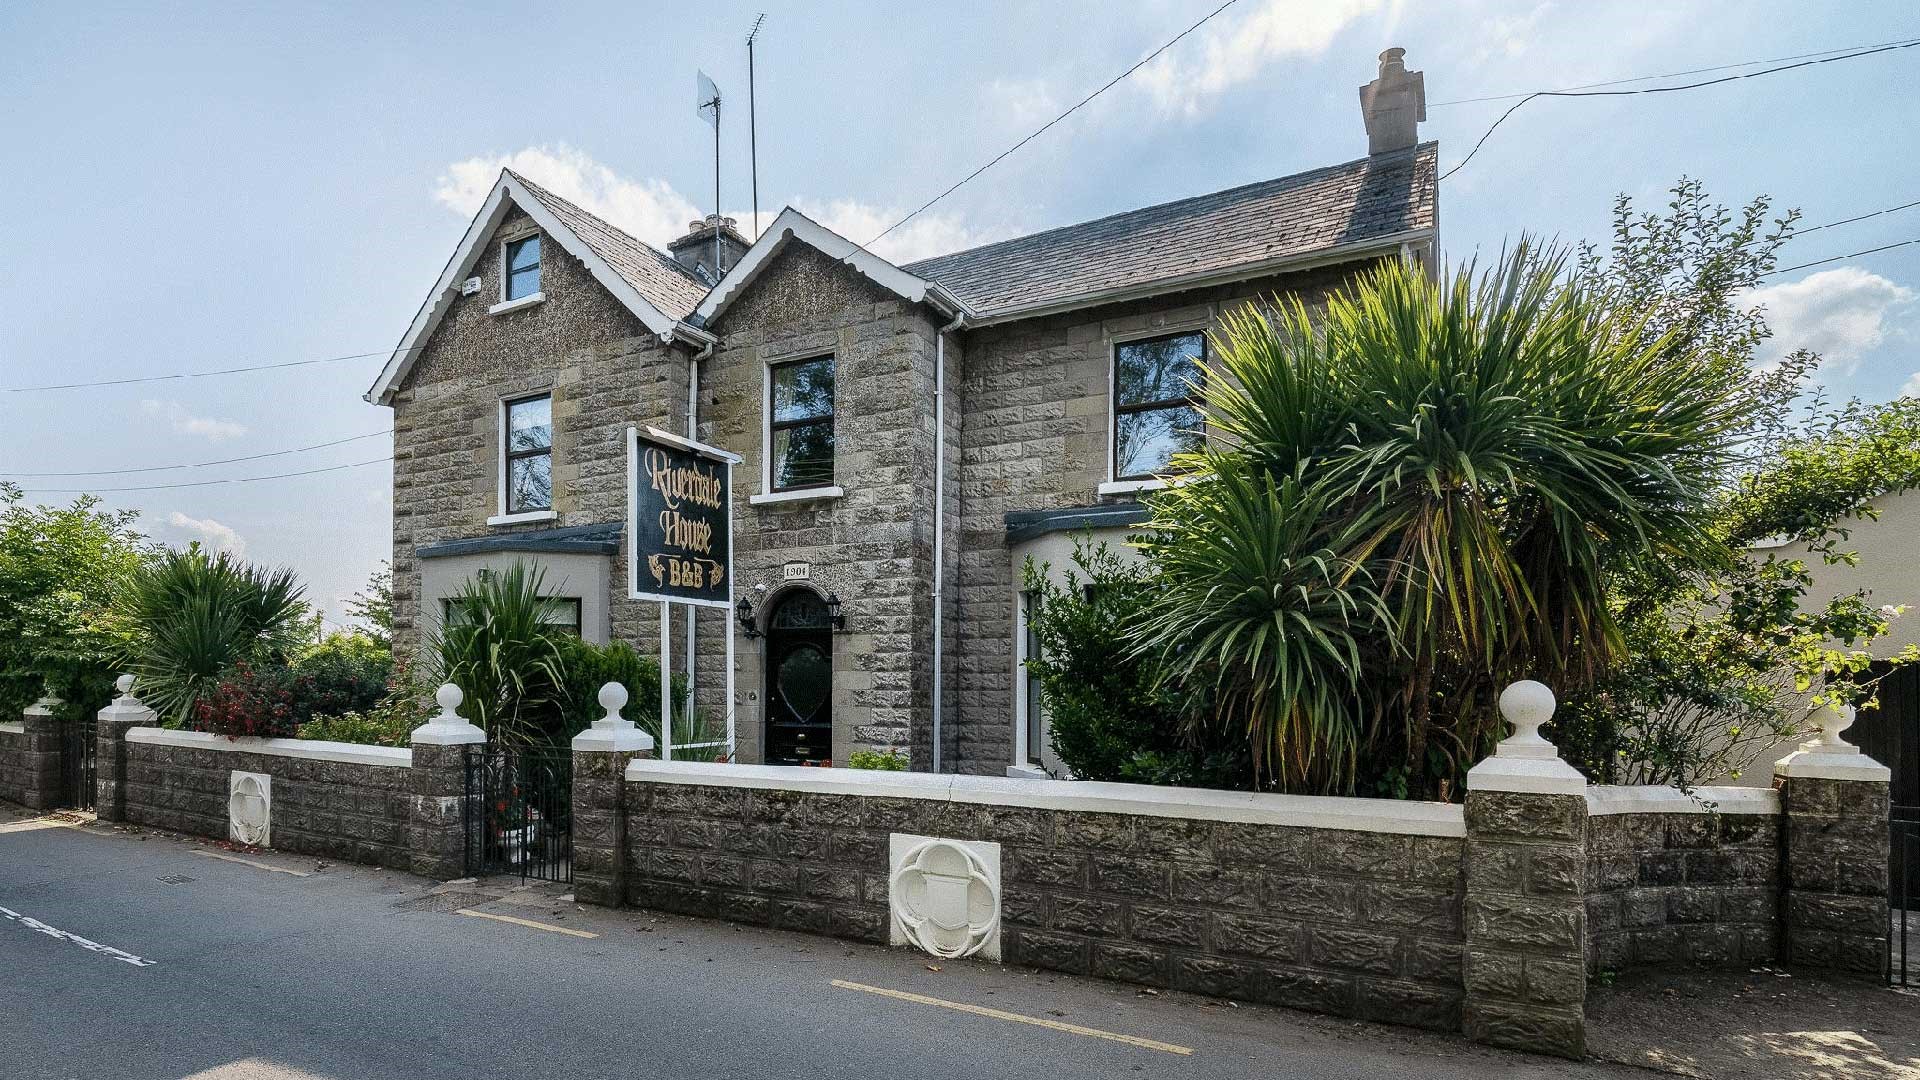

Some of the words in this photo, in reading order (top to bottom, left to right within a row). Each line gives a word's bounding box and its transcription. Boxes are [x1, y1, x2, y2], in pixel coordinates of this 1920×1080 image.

[644, 448, 722, 510] Riverdale
[659, 510, 712, 555] House
[669, 558, 703, 589] B&B
